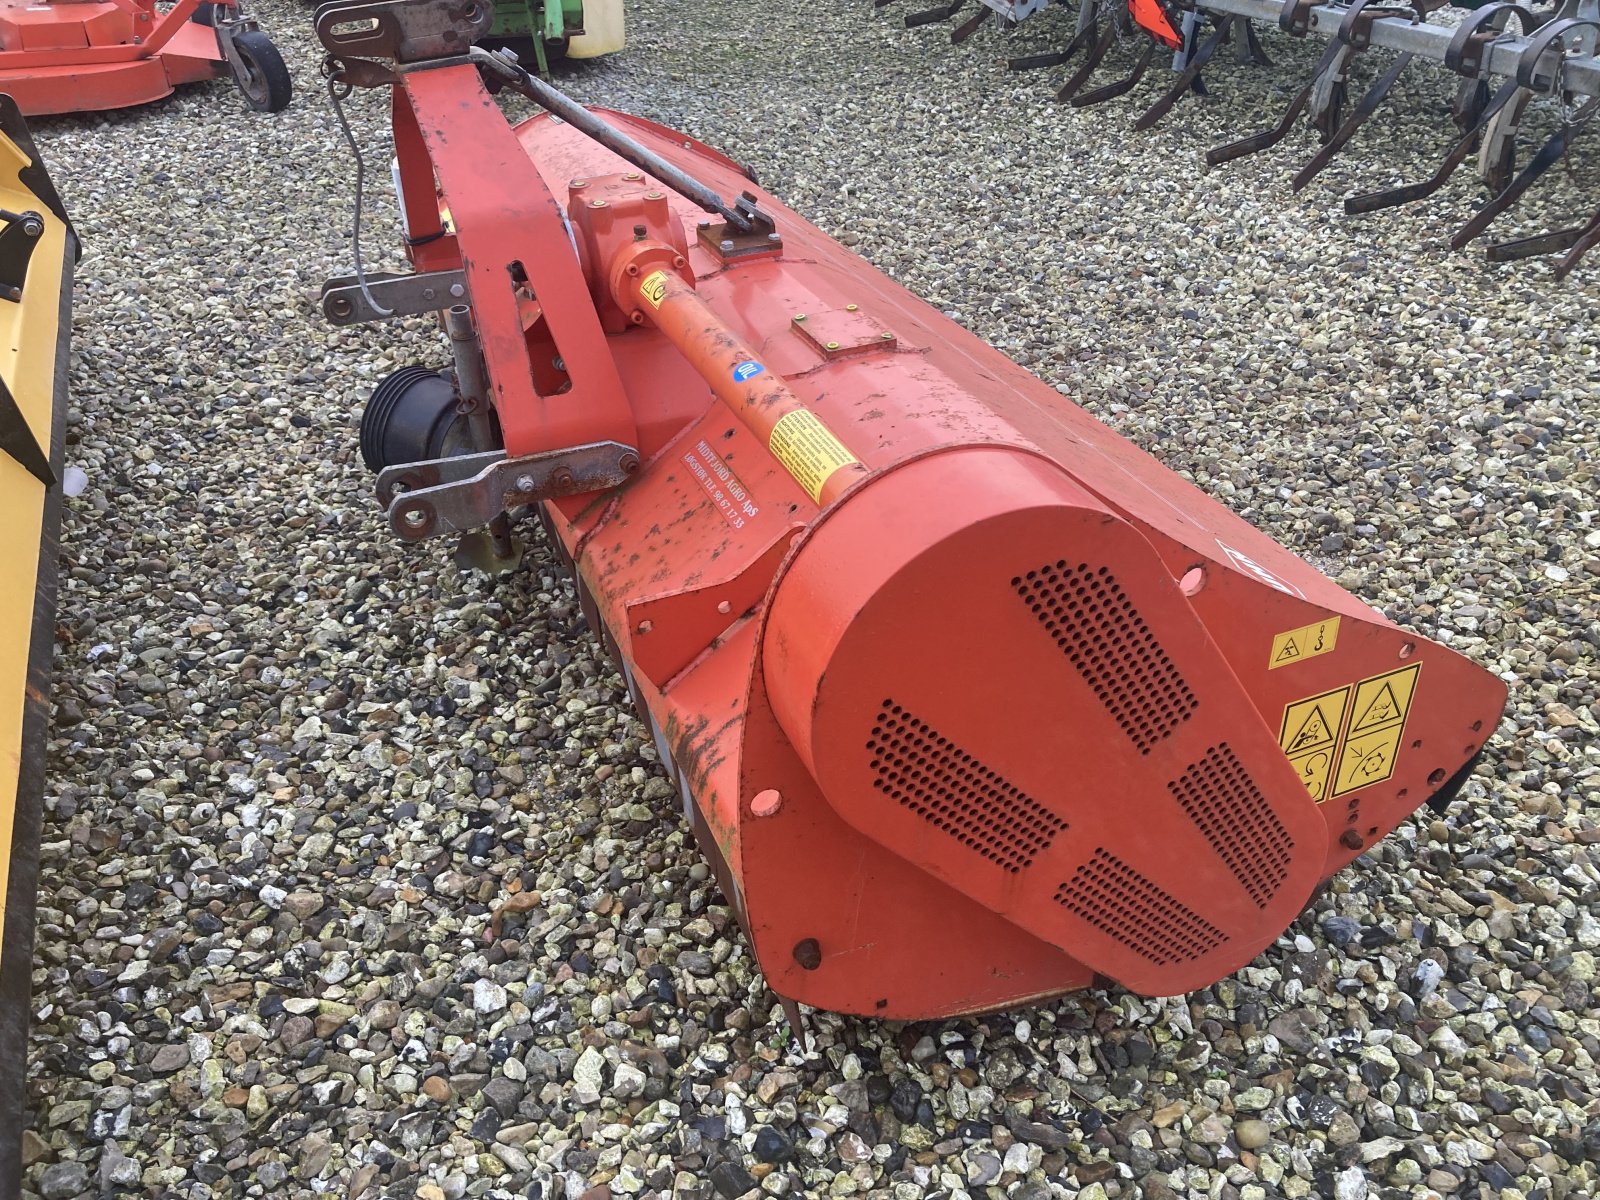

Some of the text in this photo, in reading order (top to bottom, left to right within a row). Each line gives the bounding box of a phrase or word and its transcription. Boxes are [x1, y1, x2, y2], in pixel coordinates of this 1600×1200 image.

[737, 363, 758, 380] OIL
[695, 440, 759, 517] MIDTFJORD AGRO ApS
[704, 478, 717, 493] TLF.
[713, 490, 724, 502] 98
[720, 499, 731, 510] 67
[727, 508, 738, 519] 17
[733, 517, 745, 528] 33
